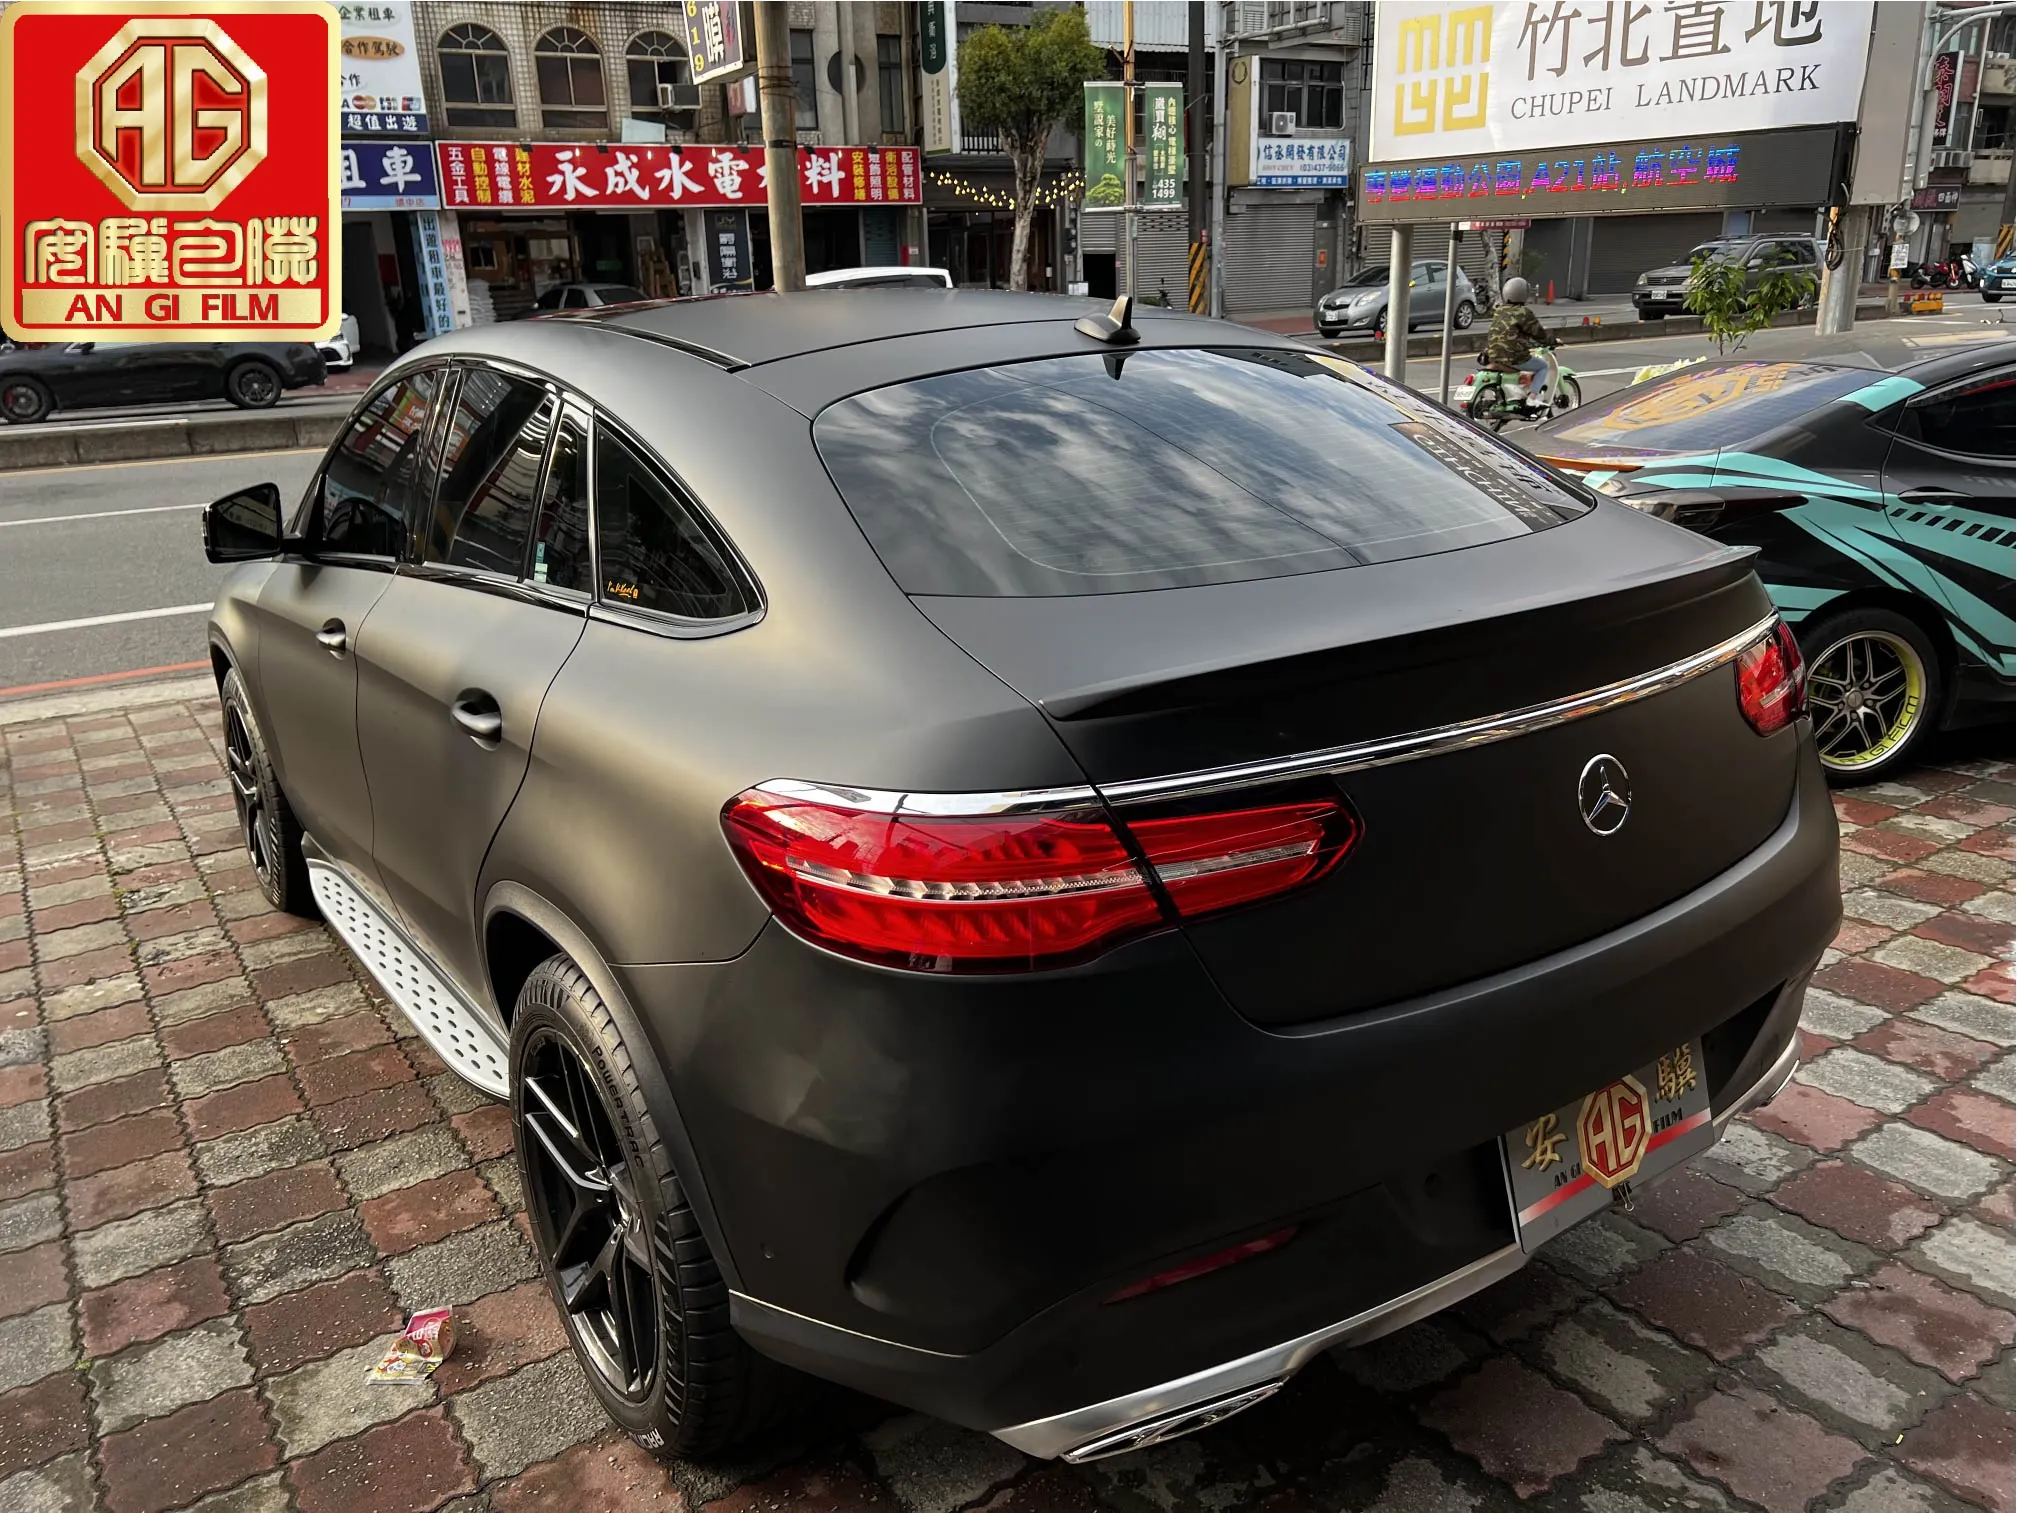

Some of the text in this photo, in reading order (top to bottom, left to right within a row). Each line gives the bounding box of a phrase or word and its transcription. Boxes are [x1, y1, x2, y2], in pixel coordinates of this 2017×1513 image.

[1511, 64, 1822, 119] CHUPEI LANDMARK
[347, 113, 418, 131] 超值出遊
[448, 147, 470, 204] 五金工具
[471, 147, 491, 203] 自動控制
[546, 150, 846, 201] 永成水電料
[1152, 189, 1176, 199] 1499
[1157, 179, 1176, 189] 435
[1521, 1113, 1568, 1172] 安
[1585, 1080, 1642, 1173] AG
[1652, 1107, 1683, 1133] FILM
